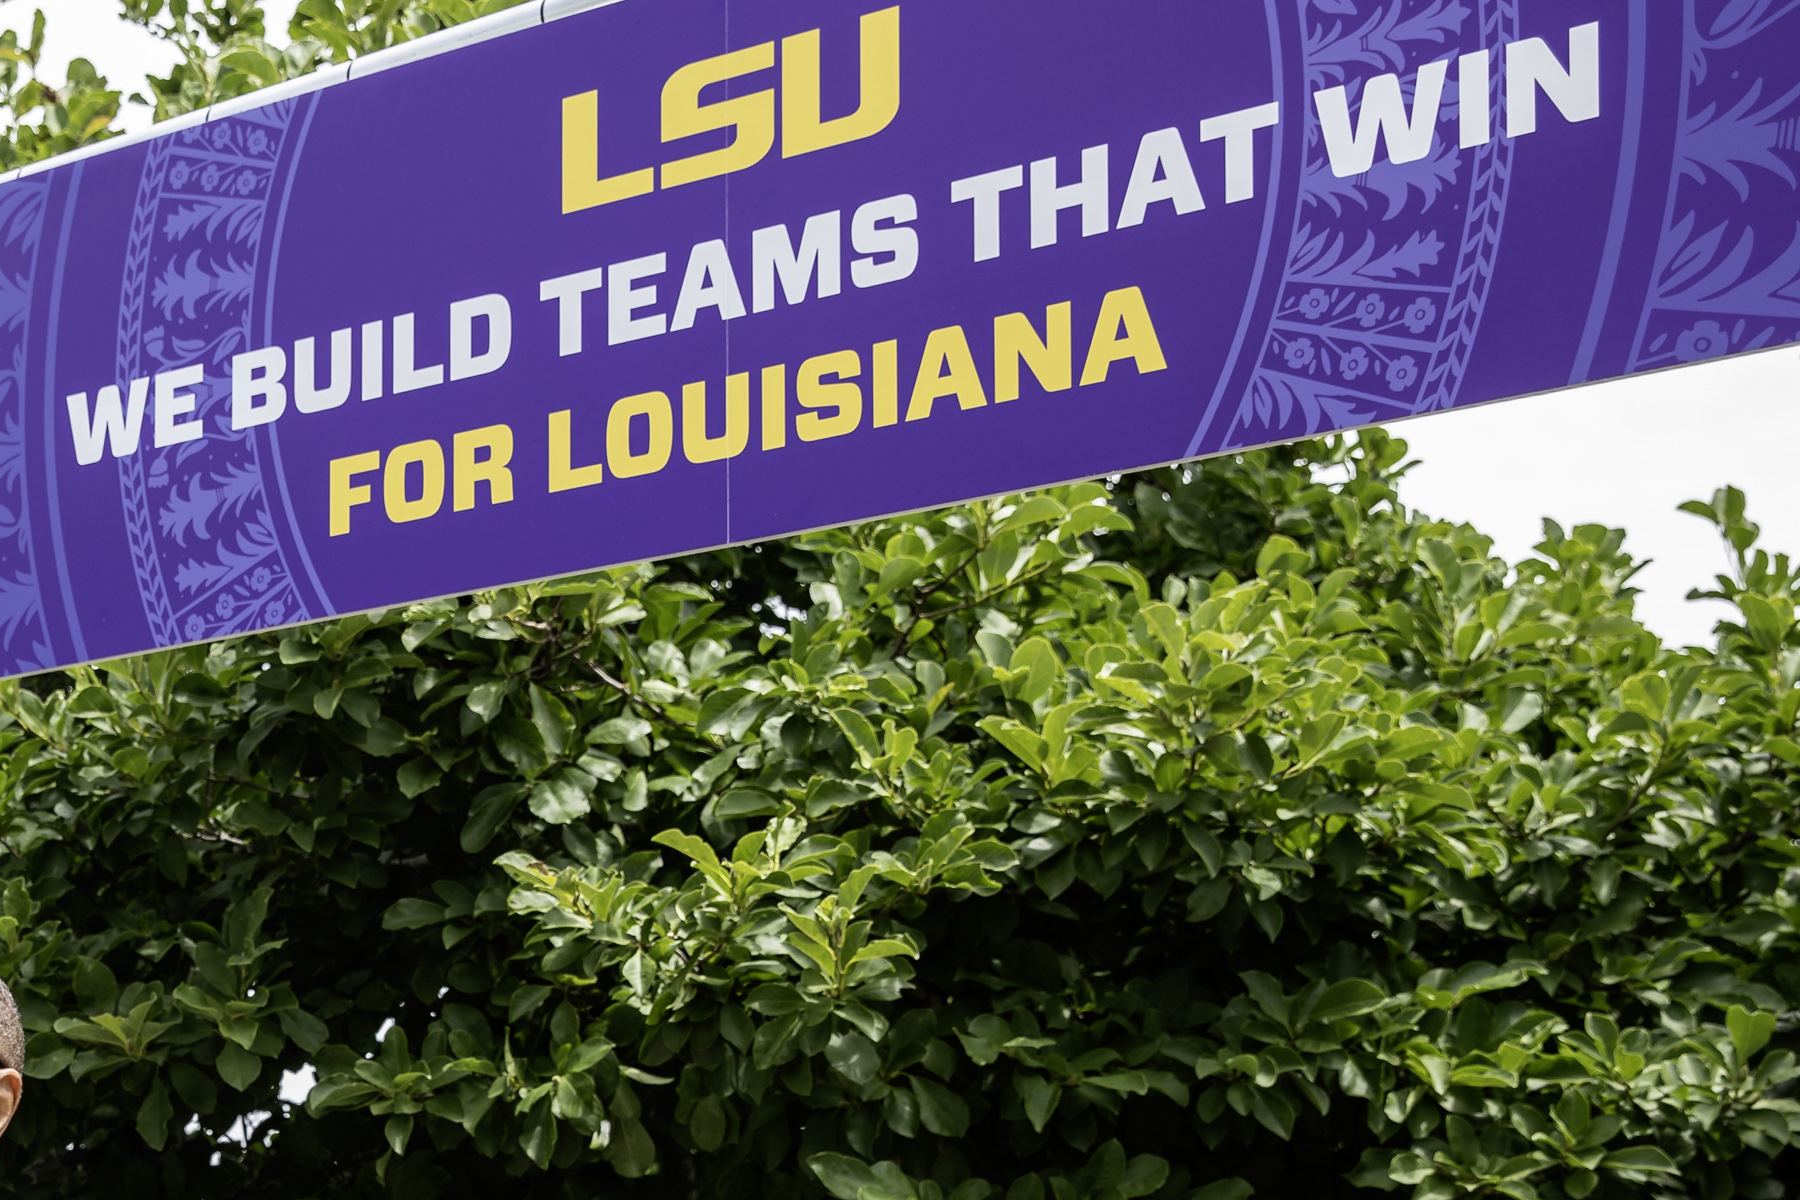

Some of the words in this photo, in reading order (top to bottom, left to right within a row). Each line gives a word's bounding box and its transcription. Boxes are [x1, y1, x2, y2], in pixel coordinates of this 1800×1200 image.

[560, 4, 901, 216] LSU
[66, 362, 205, 466] WE
[230, 292, 513, 432] BUILD
[538, 192, 920, 358] TEAMS
[950, 100, 1281, 264] THAT
[1312, 20, 1601, 179] WIN
[328, 423, 515, 538] FOR
[547, 285, 1169, 495] LOUISIANA
